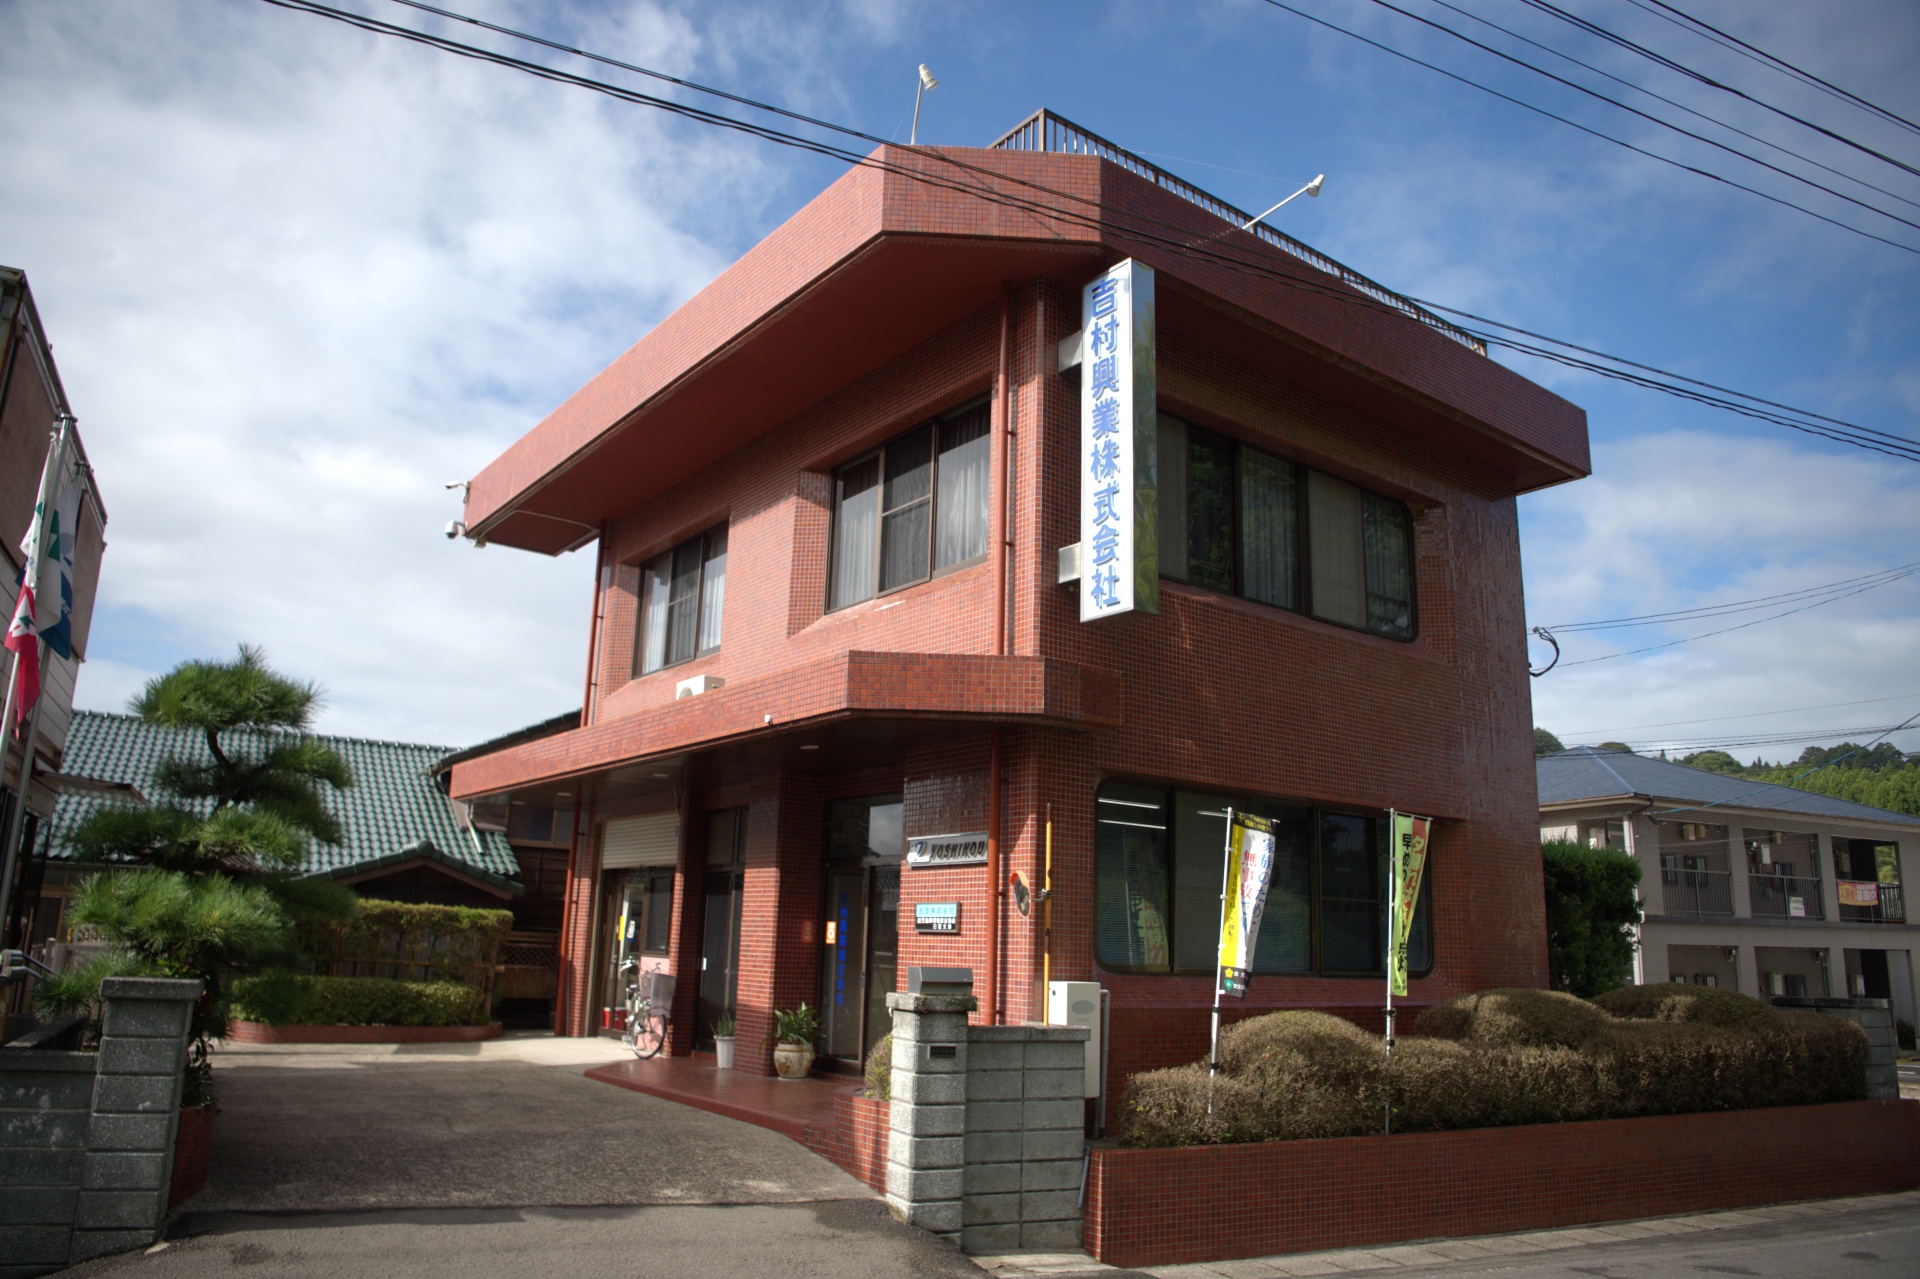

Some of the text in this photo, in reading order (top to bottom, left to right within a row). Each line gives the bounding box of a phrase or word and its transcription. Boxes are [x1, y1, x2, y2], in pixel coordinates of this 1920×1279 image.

[1091, 278, 1121, 608] 吉村興業株式会社
[931, 841, 985, 858] YOSHIKOU
